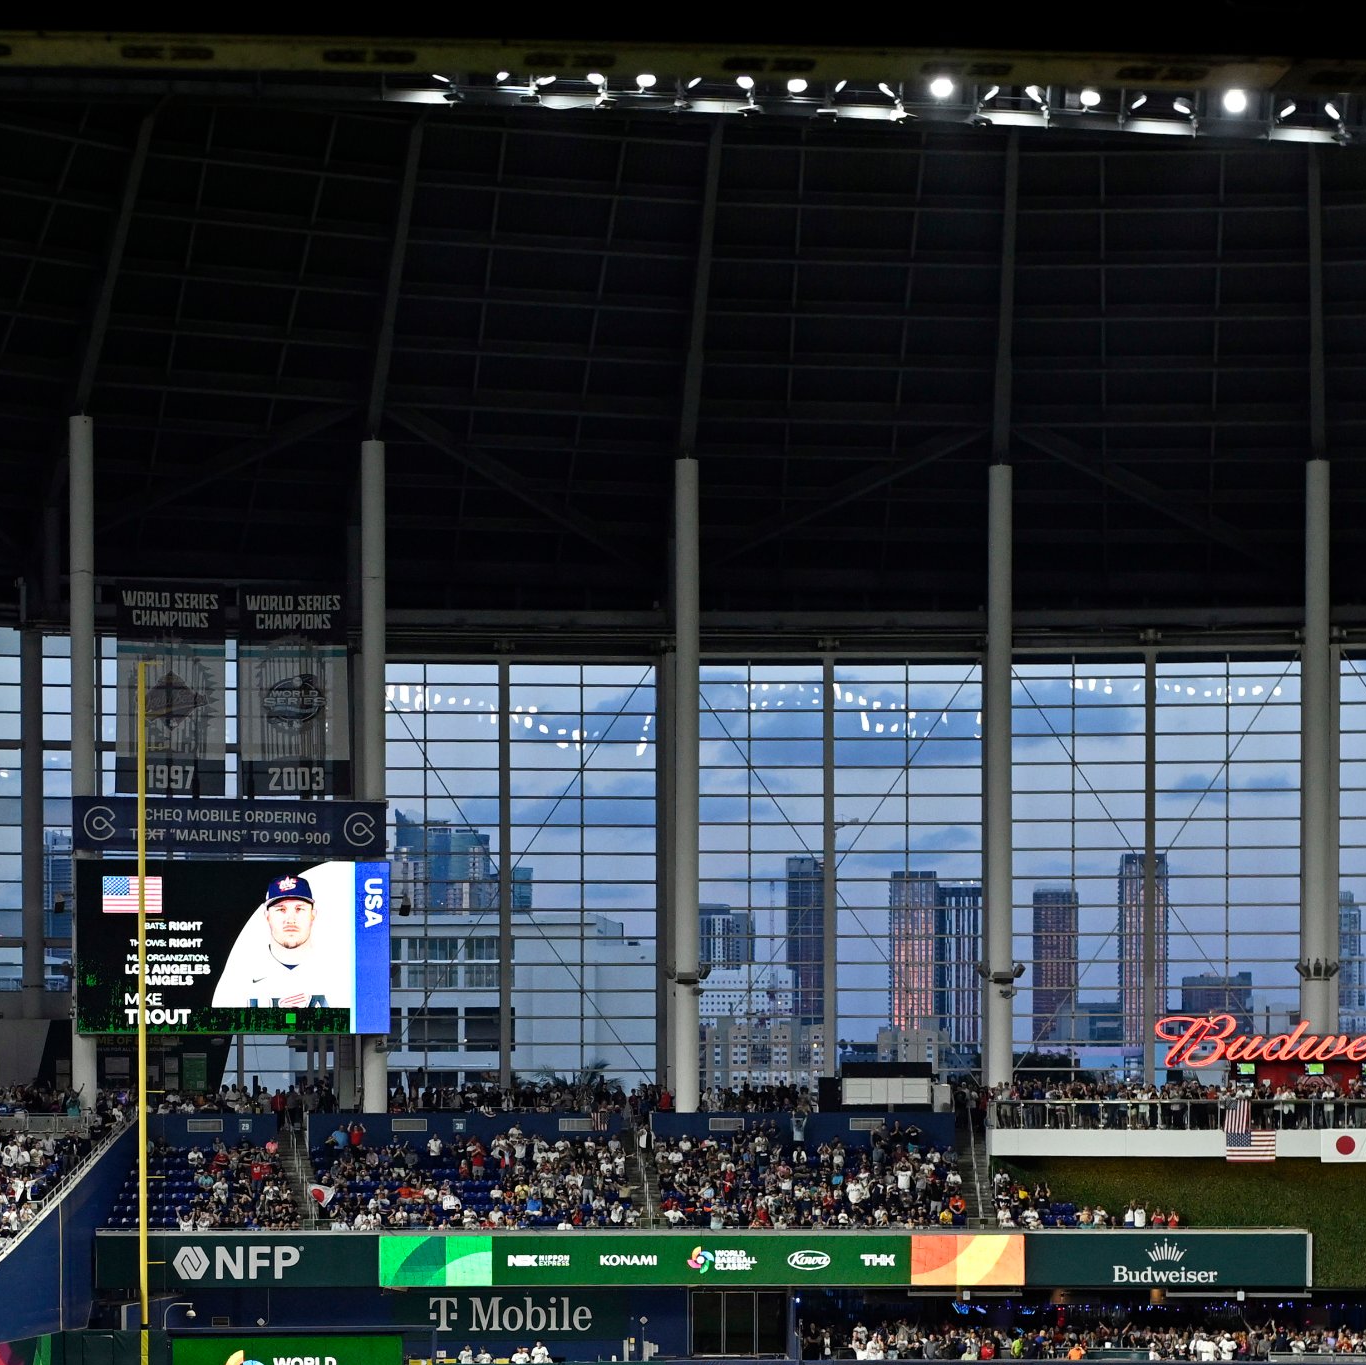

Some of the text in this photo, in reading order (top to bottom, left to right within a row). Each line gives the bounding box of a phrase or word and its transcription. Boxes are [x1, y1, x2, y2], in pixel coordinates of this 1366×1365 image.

[122, 590, 219, 610] WORLD SERIES
[246, 595, 341, 611] WORLD SERIES
[133, 609, 209, 628] CHAMPIONS
[256, 613, 331, 630] CHAMPIONS
[270, 690, 319, 698] WORLD
[263, 697, 327, 707] SERIES
[146, 764, 195, 790] 1997
[268, 767, 325, 791] 2003
[144, 809, 317, 825] CHEQ MOBILE ORDERING
[130, 828, 167, 841] TXT
[251, 830, 270, 843] TO
[274, 832, 331, 845] 900-900
[364, 878, 383, 928] USA
[169, 921, 203, 931] RIGHT
[129, 938, 203, 948] THOWS: RIGHT
[147, 954, 209, 962] ORGANIZATION:
[152, 964, 211, 975] ANGELES
[145, 975, 194, 986] ANGELS
[125, 993, 163, 1005] MKE
[215, 1246, 299, 1279] NFP
[600, 1255, 657, 1266] KONAMI
[714, 1256, 758, 1264] BASEBALL
[791, 1252, 829, 1267] Kowa
[861, 1254, 895, 1266] THK
[1113, 1264, 1218, 1283] Budweiser
[469, 1297, 592, 1332] Mobile
